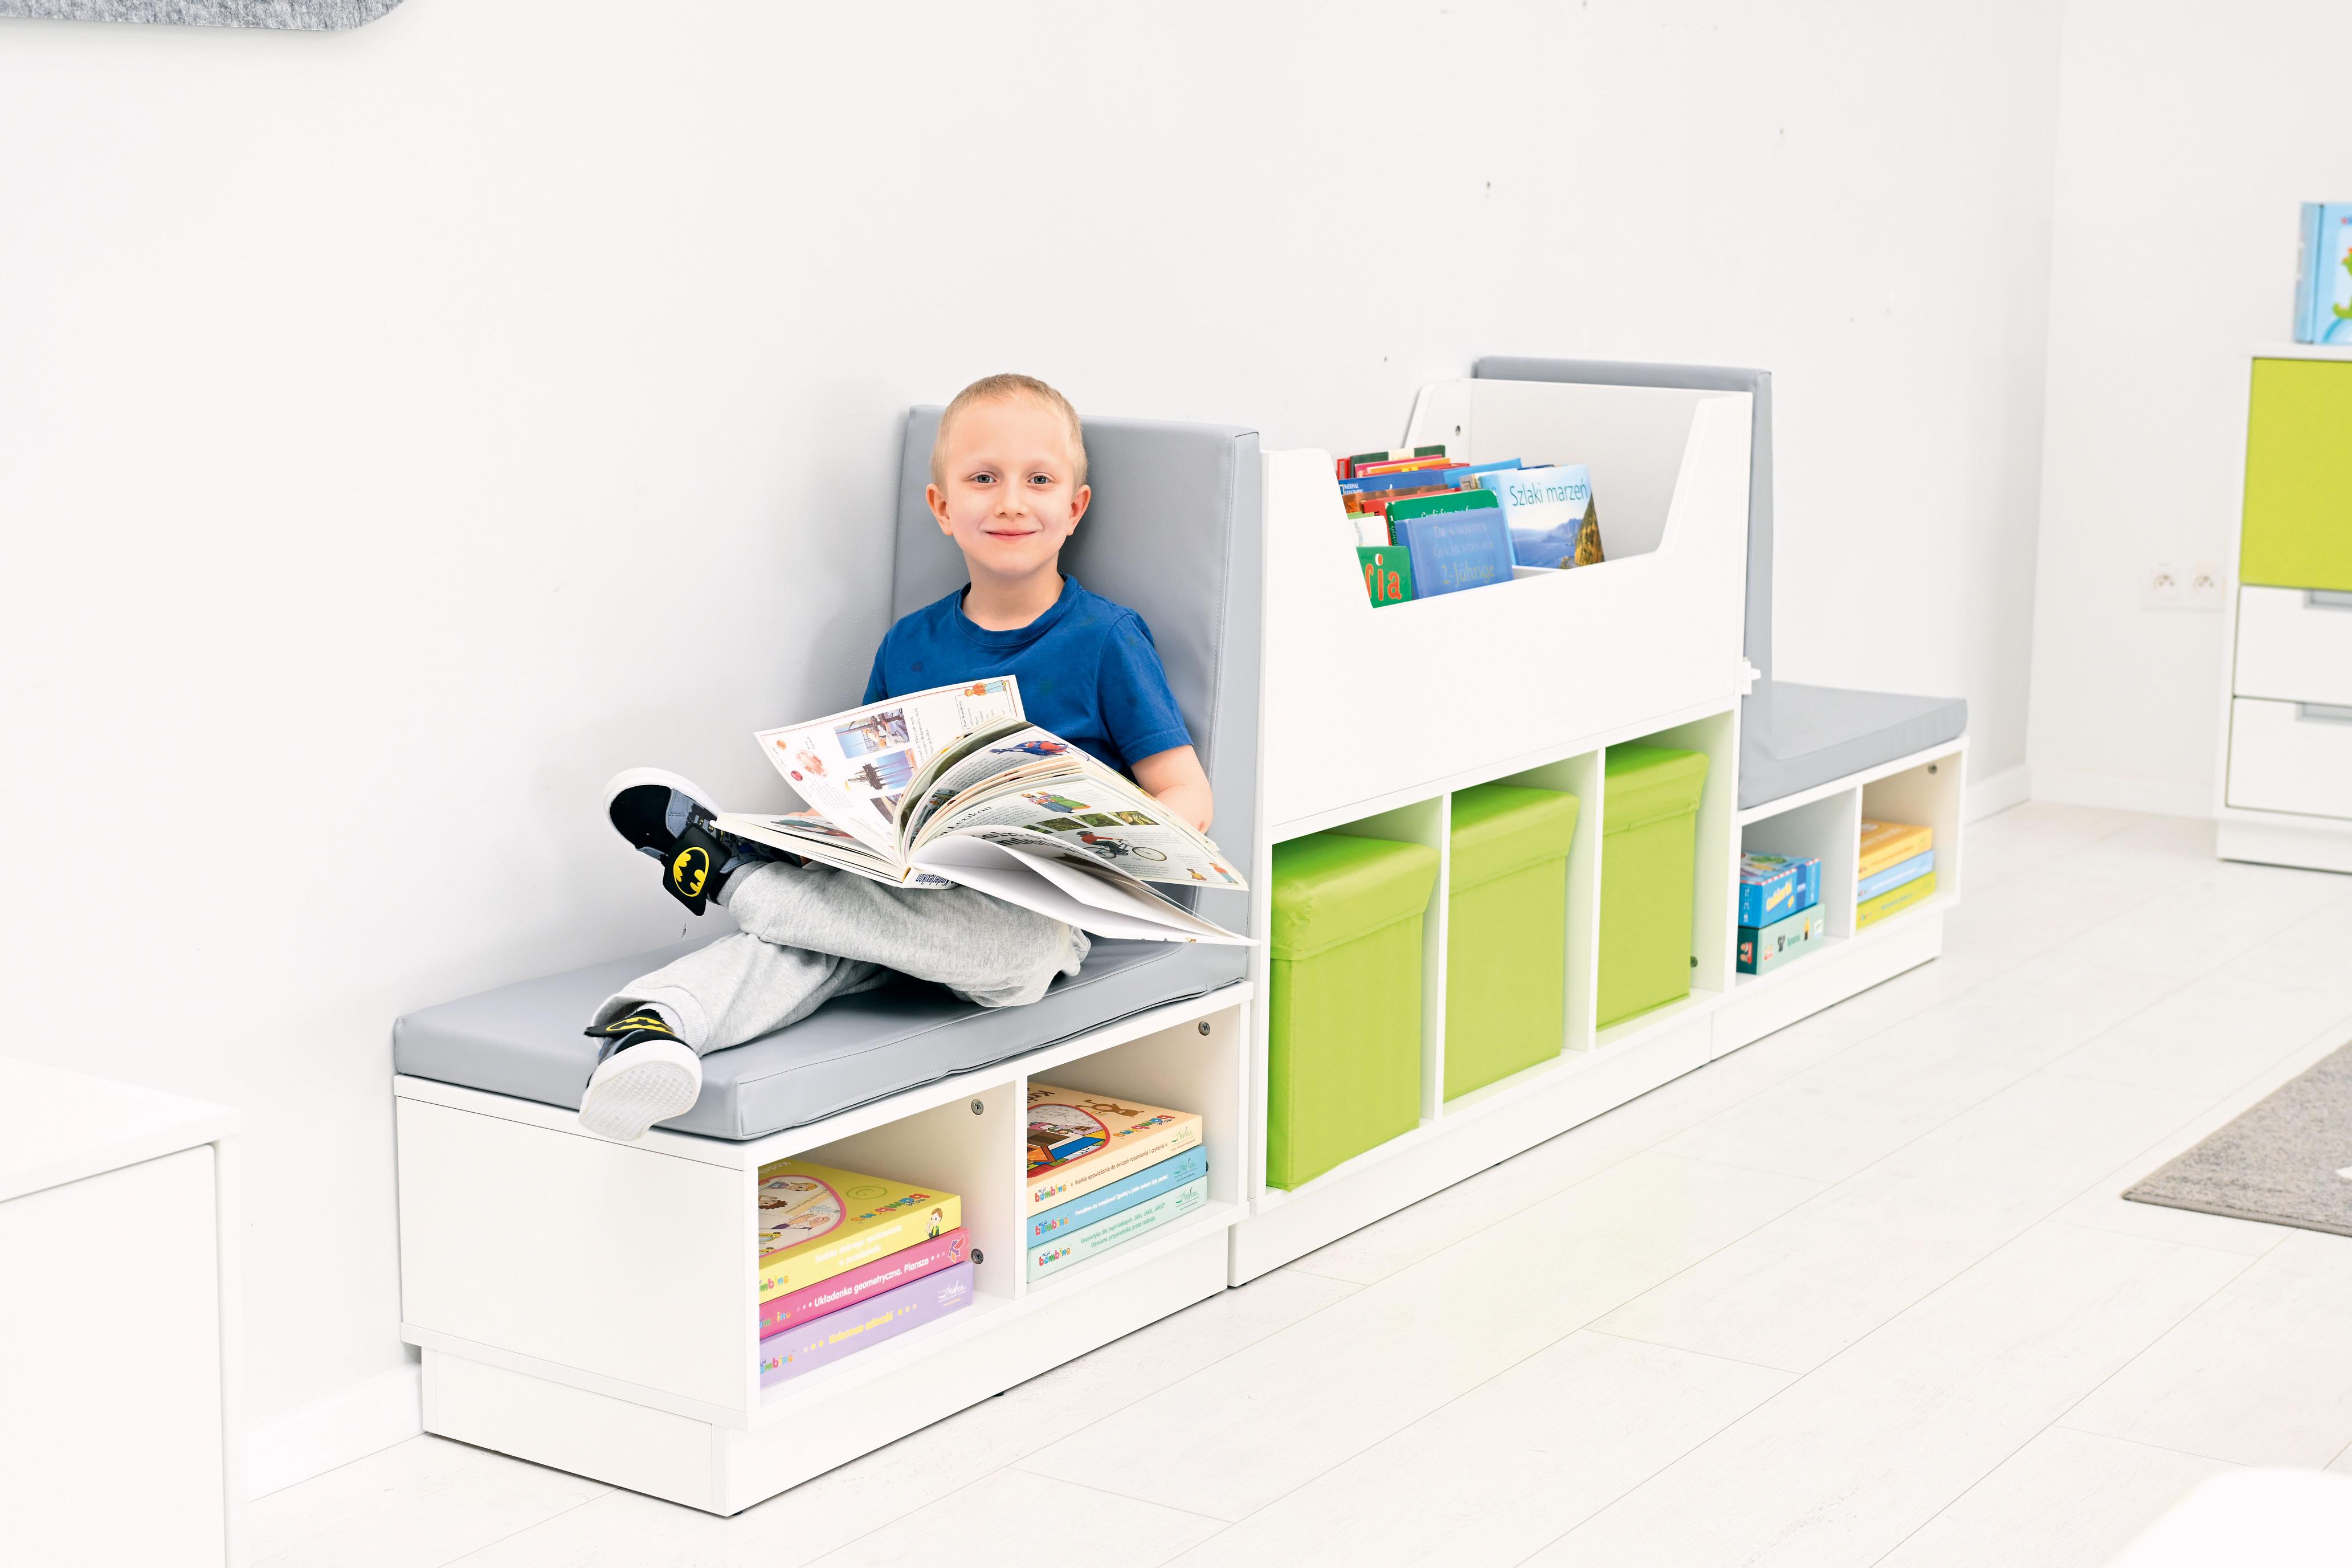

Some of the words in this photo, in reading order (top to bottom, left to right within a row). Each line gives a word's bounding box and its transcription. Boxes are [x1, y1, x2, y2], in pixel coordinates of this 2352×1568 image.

[1510, 483, 1543, 506] Szlaki
[1547, 479, 1588, 503] marzeń
[1442, 560, 1494, 587] 2-Jährige
[948, 806, 992, 829] Lexikon
[1035, 1184, 1067, 1203] bambino
[1076, 1175, 1087, 1185] Krótkie
[1088, 1166, 1110, 1180] opowiadania
[1116, 1158, 1129, 1168] ćwiczeń
[1130, 1150, 1148, 1162] rozumienia
[1151, 1143, 1164, 1154] czytania
[1035, 1217, 1069, 1235] bambino
[1081, 1230, 1101, 1245] Gramatyka
[1091, 1236, 1108, 1248] Odmiana
[1039, 1247, 1071, 1267] bambino
[760, 1275, 789, 1292] mbino
[815, 1287, 852, 1306] Układanka
[854, 1270, 902, 1294] geometryczna.
[904, 1257, 929, 1273] Plansze
[760, 1354, 794, 1374] ambino
